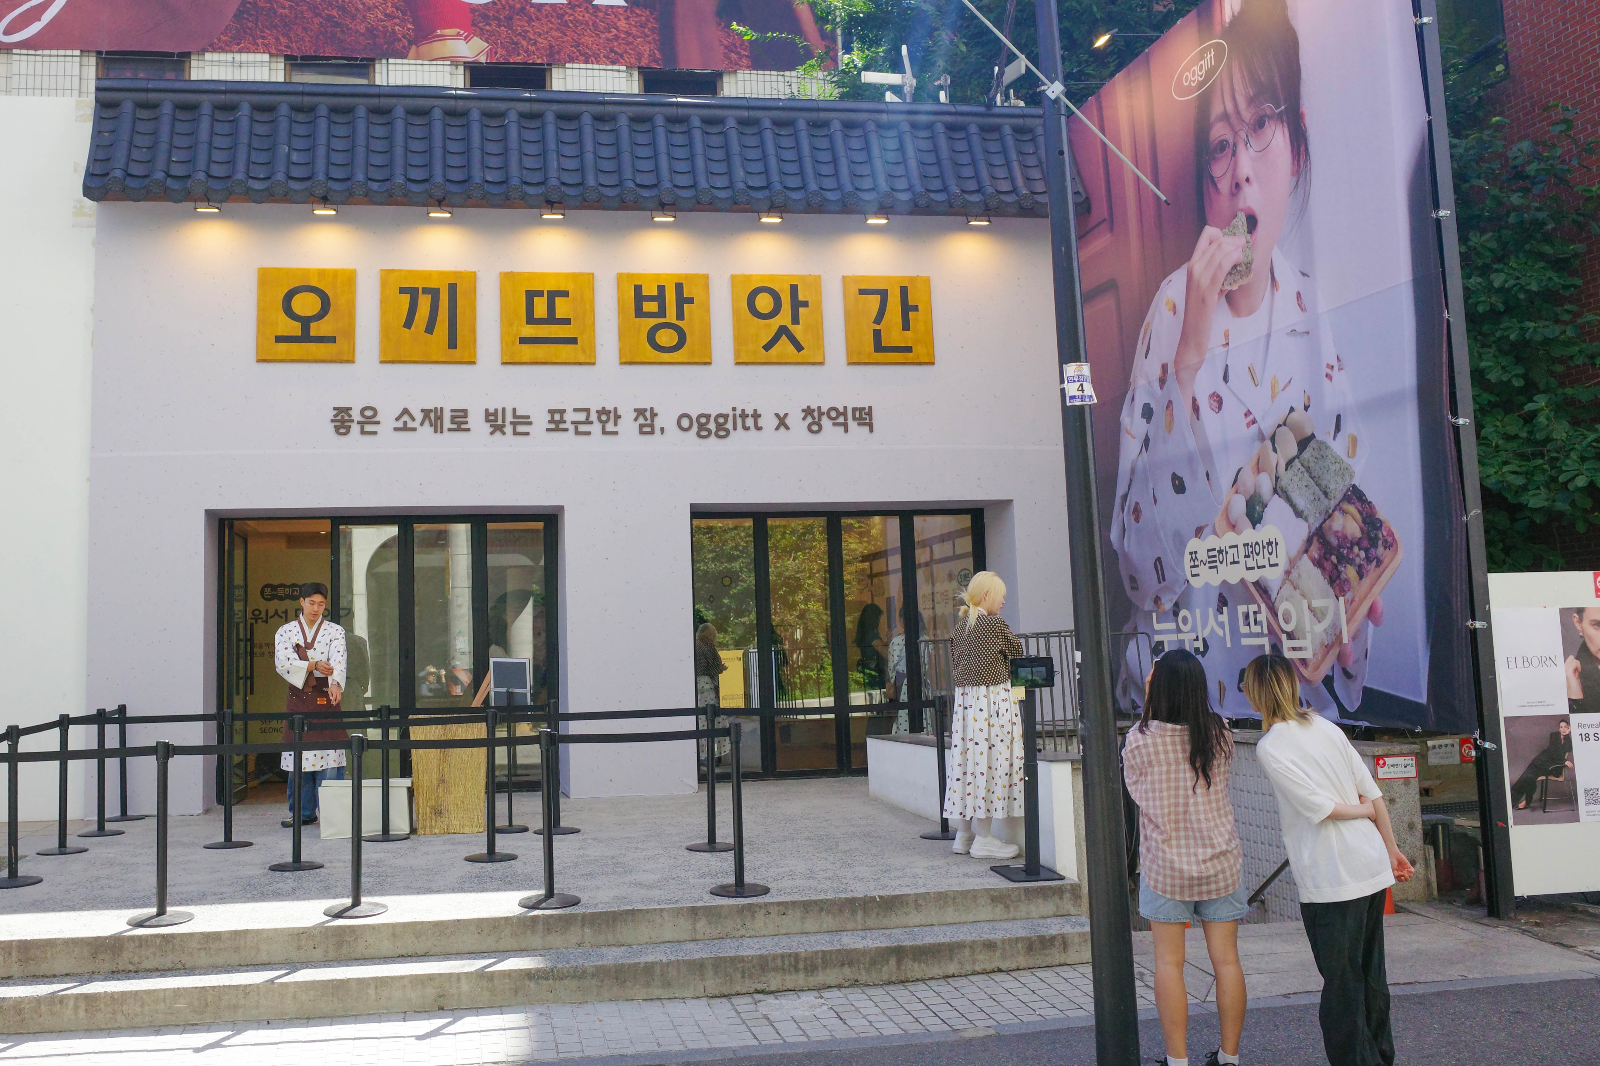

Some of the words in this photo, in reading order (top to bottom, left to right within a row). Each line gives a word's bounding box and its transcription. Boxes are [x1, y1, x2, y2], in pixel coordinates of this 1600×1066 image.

[1183, 48, 1215, 87] oggitt
[1076, 383, 1086, 394] 4
[331, 406, 380, 436] 좋은
[393, 406, 471, 434] 소재로
[485, 406, 533, 436] 빚는
[545, 406, 622, 435] 포근한
[633, 406, 665, 435] 잠,
[676, 406, 763, 439] oggitt
[774, 412, 790, 431] x
[801, 405, 874, 434] 창억떡
[1189, 544, 1241, 578] 쫀~득하고
[1243, 537, 1280, 571] 편안한
[249, 608, 288, 624] 워서
[1152, 607, 1232, 652] 누워서
[1237, 603, 1270, 655] 떡
[1277, 597, 1349, 659] 입기
[1506, 655, 1558, 669] ELBORN
[1579, 732, 1591, 742] 18
